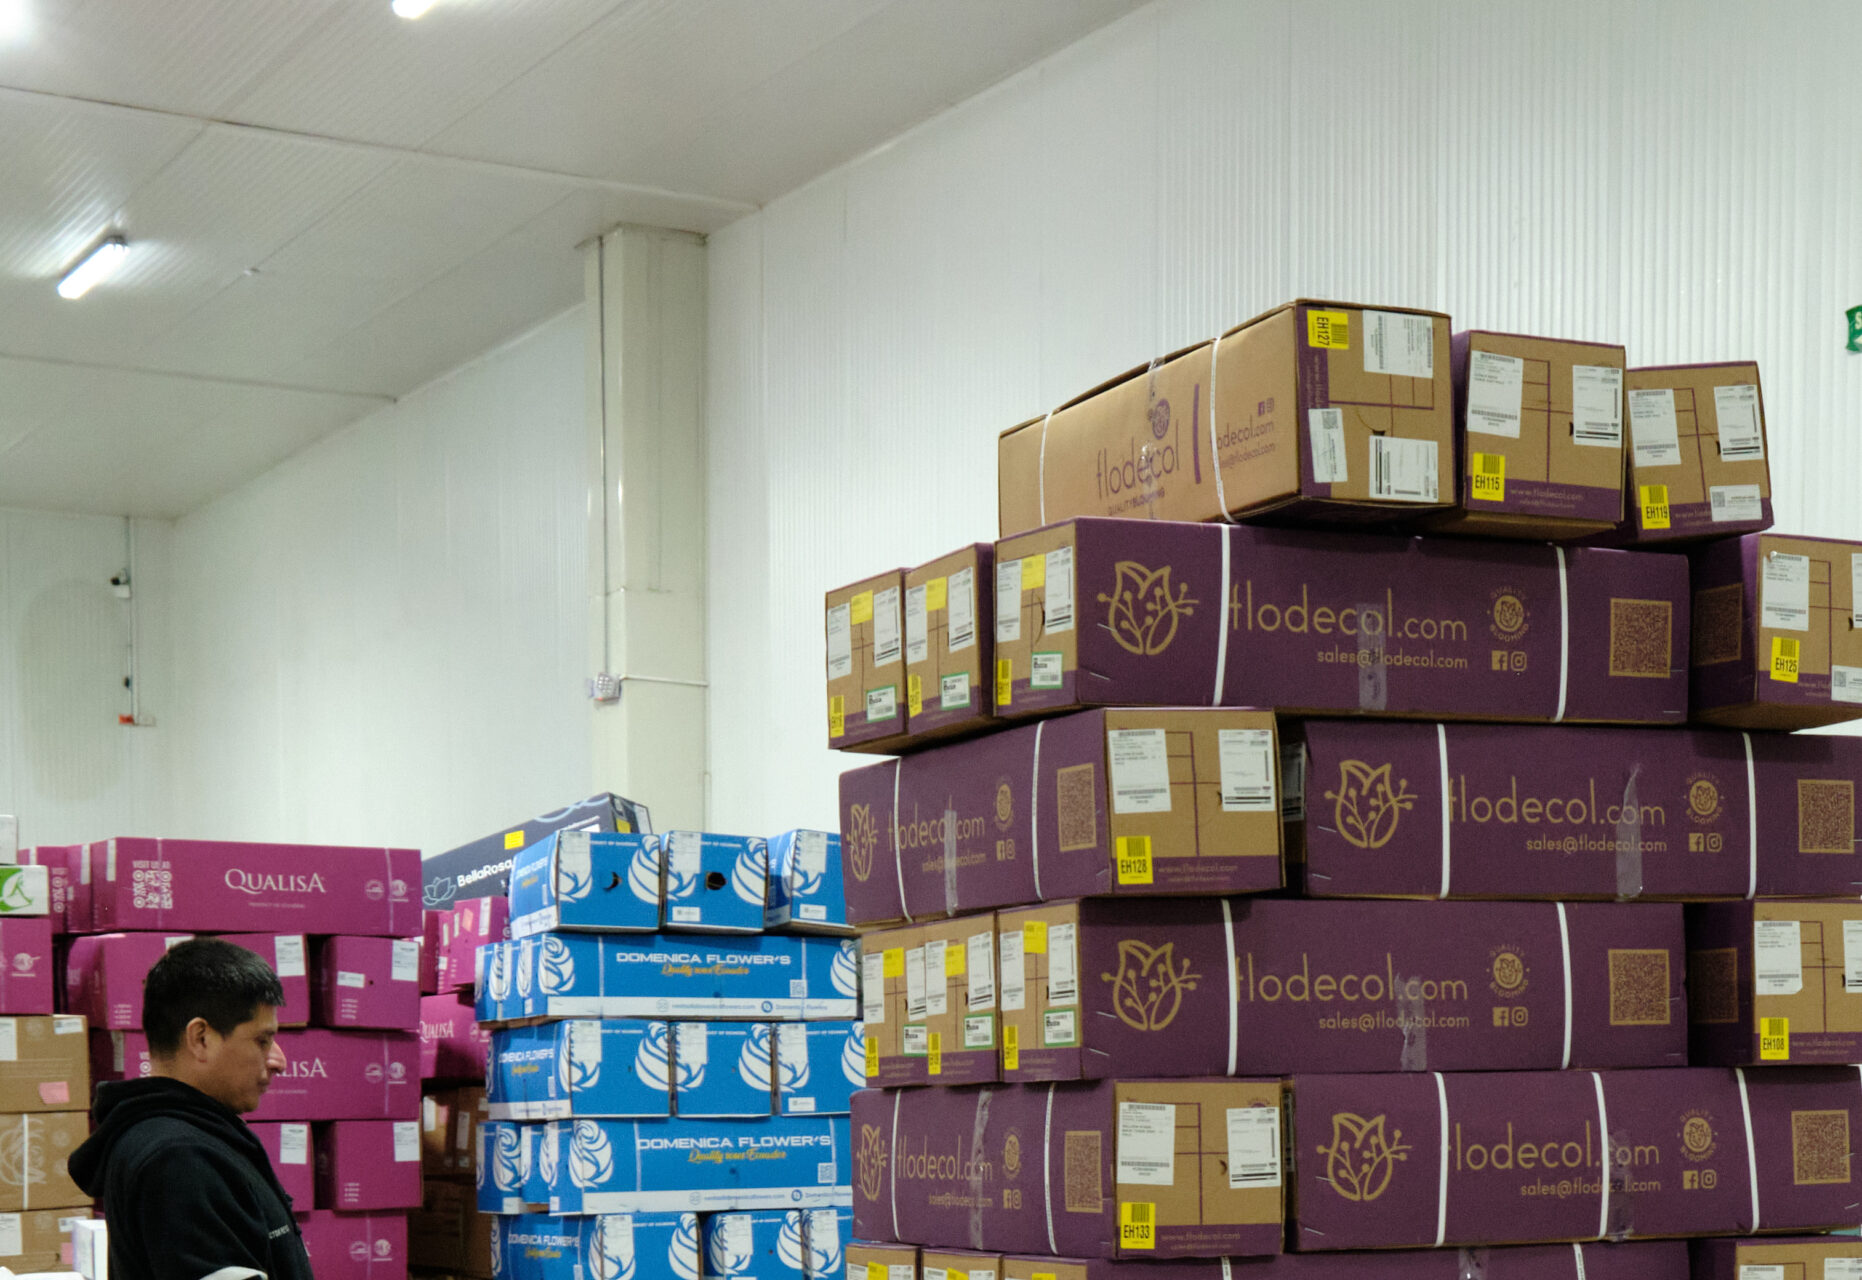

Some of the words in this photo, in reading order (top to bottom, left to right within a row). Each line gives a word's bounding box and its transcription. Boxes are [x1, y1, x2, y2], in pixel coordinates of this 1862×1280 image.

[1316, 316, 1329, 347] EH127
[1210, 414, 1275, 451] odecol.com
[1475, 475, 1500, 492] EH115
[1645, 504, 1669, 520] EH119
[1229, 580, 1467, 641] flodecol.com
[1317, 644, 1468, 670] sales@lodecol.com
[1775, 657, 1797, 673] EH125
[1526, 833, 1667, 855] sales@flodecol.com
[457, 859, 513, 887] BellaRosa
[1120, 858, 1148, 874] EH128
[616, 952, 702, 963] DOMENICA
[706, 953, 791, 965] FLOWER'S
[1763, 1037, 1785, 1051] EH108
[637, 1137, 733, 1150] DOMENICA
[738, 1135, 832, 1148] FLOWER'S
[1448, 1120, 1660, 1170] lodecol.om
[1123, 1223, 1150, 1240] EH133
